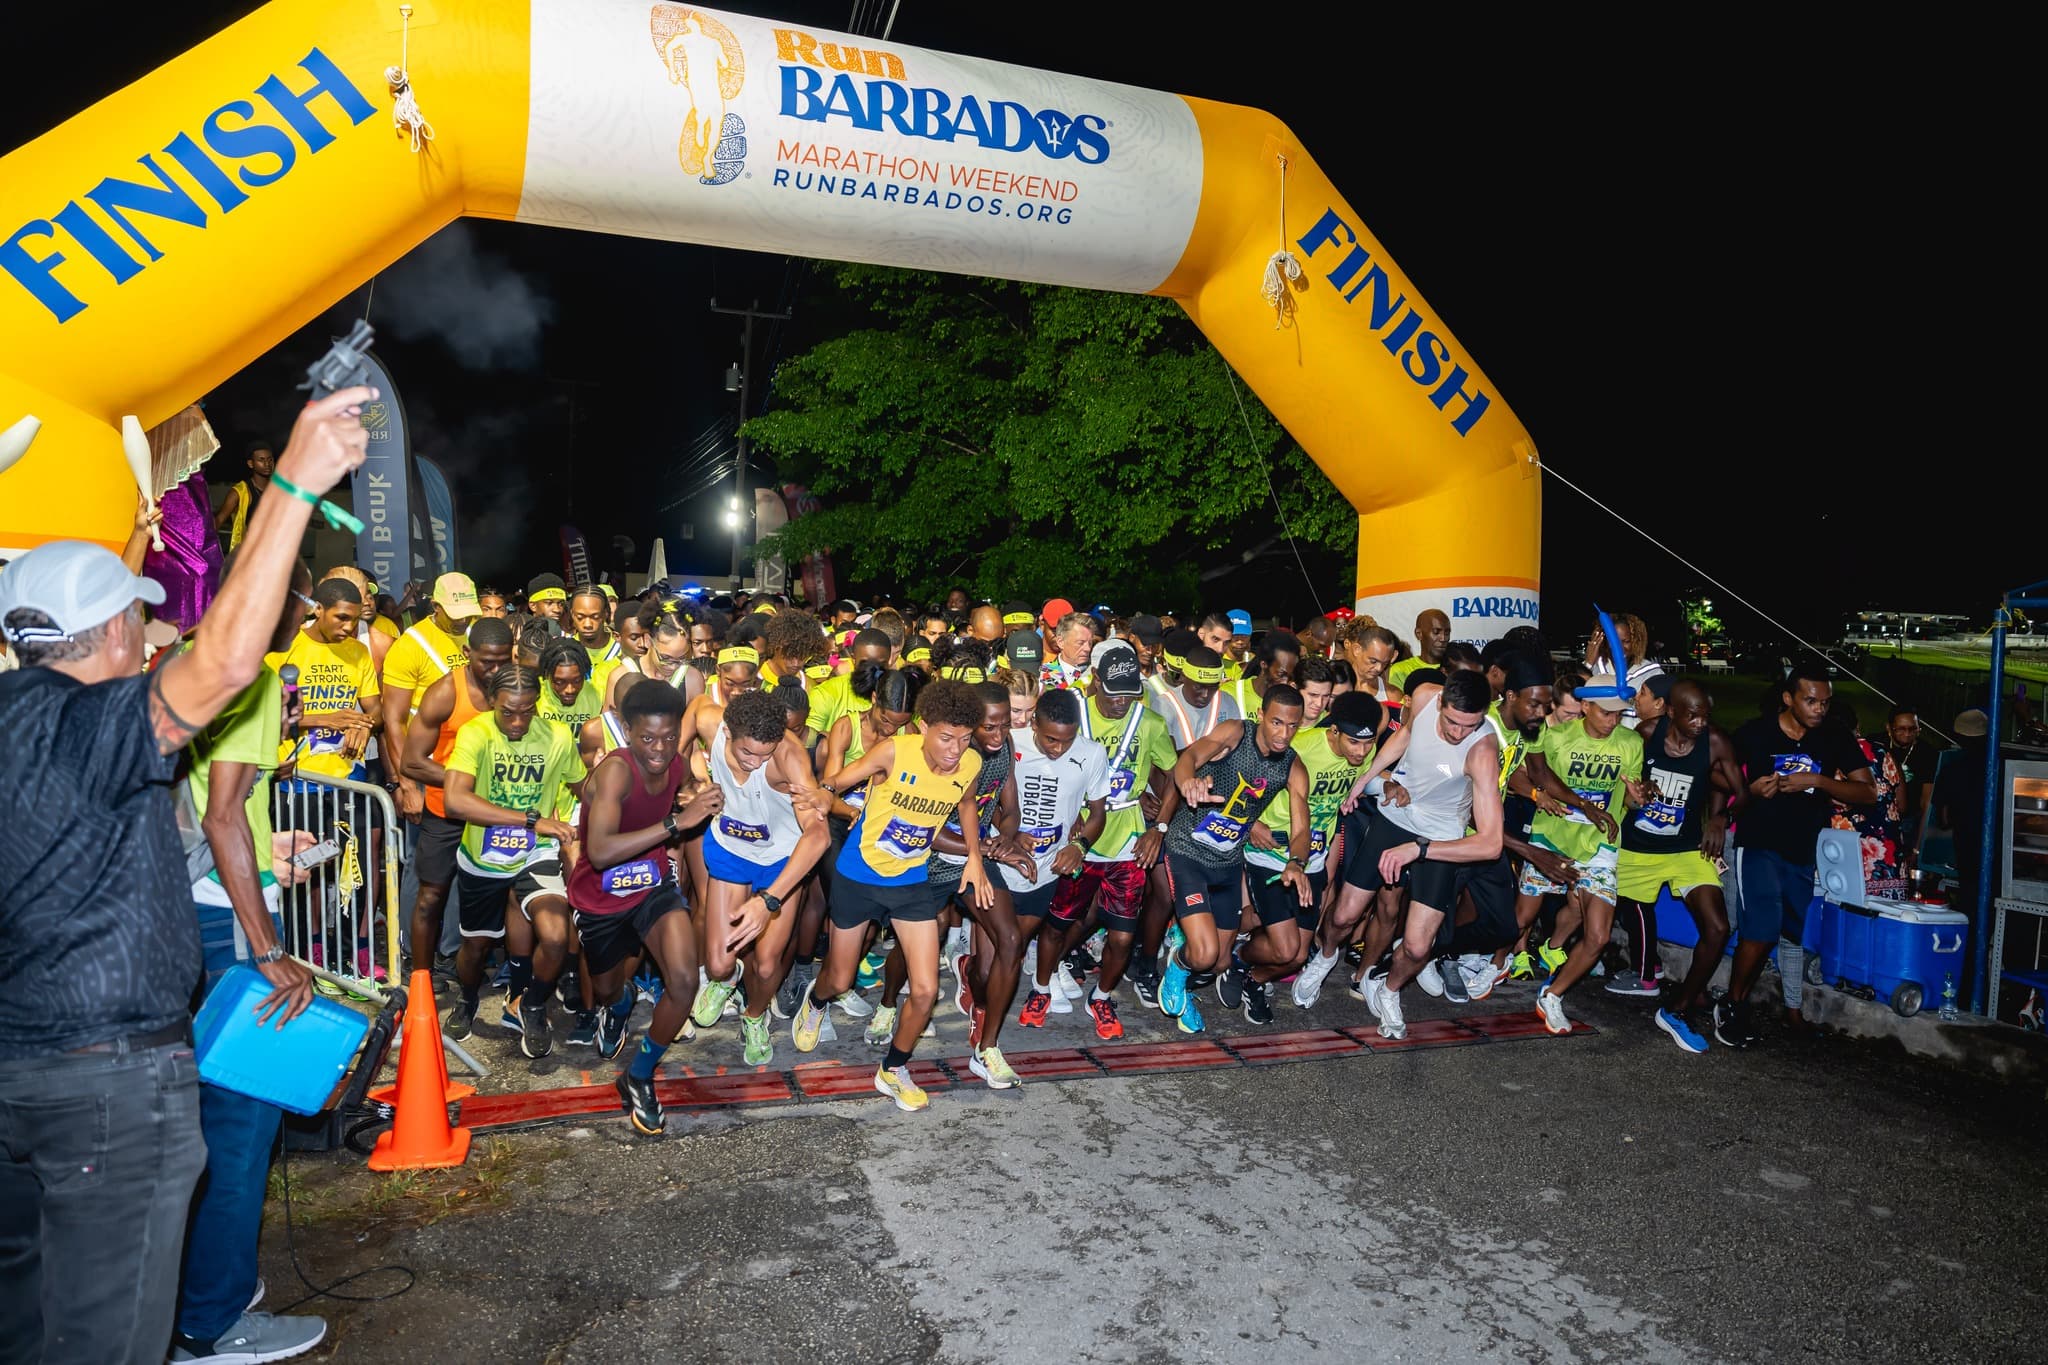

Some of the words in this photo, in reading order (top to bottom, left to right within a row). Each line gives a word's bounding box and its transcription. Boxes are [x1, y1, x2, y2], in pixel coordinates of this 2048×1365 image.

[772, 28, 907, 81] Run
[778, 65, 1111, 165] BARBADOS
[776, 139, 940, 184] MARATHON
[950, 165, 1079, 203] WEEKEND
[0, 47, 378, 324] FINISH
[773, 168, 1073, 226] RUNBARBADOS.ORG
[1296, 206, 1491, 438] FINISH
[310, 664, 344, 674] START
[304, 674, 352, 684] STRONG.
[299, 684, 358, 700] FINISH
[303, 701, 354, 711] TRONGER
[543, 712, 564, 722] DAY
[566, 714, 591, 723] DOES
[495, 752, 513, 762] DAY
[514, 754, 545, 764] DOES
[1570, 751, 1592, 761] DAY
[1594, 754, 1622, 764] DOES
[495, 763, 546, 783] RUN
[1316, 771, 1335, 780] DAY
[1567, 760, 1621, 780] RUN
[1312, 777, 1356, 796] RUN
[1022, 774, 1041, 827] TOBAGO
[1644, 809, 1677, 824] 3734
[891, 829, 928, 847] 3389
[1206, 821, 1240, 840] 3690
[490, 835, 529, 849] 3282
[611, 872, 653, 889] 3643
